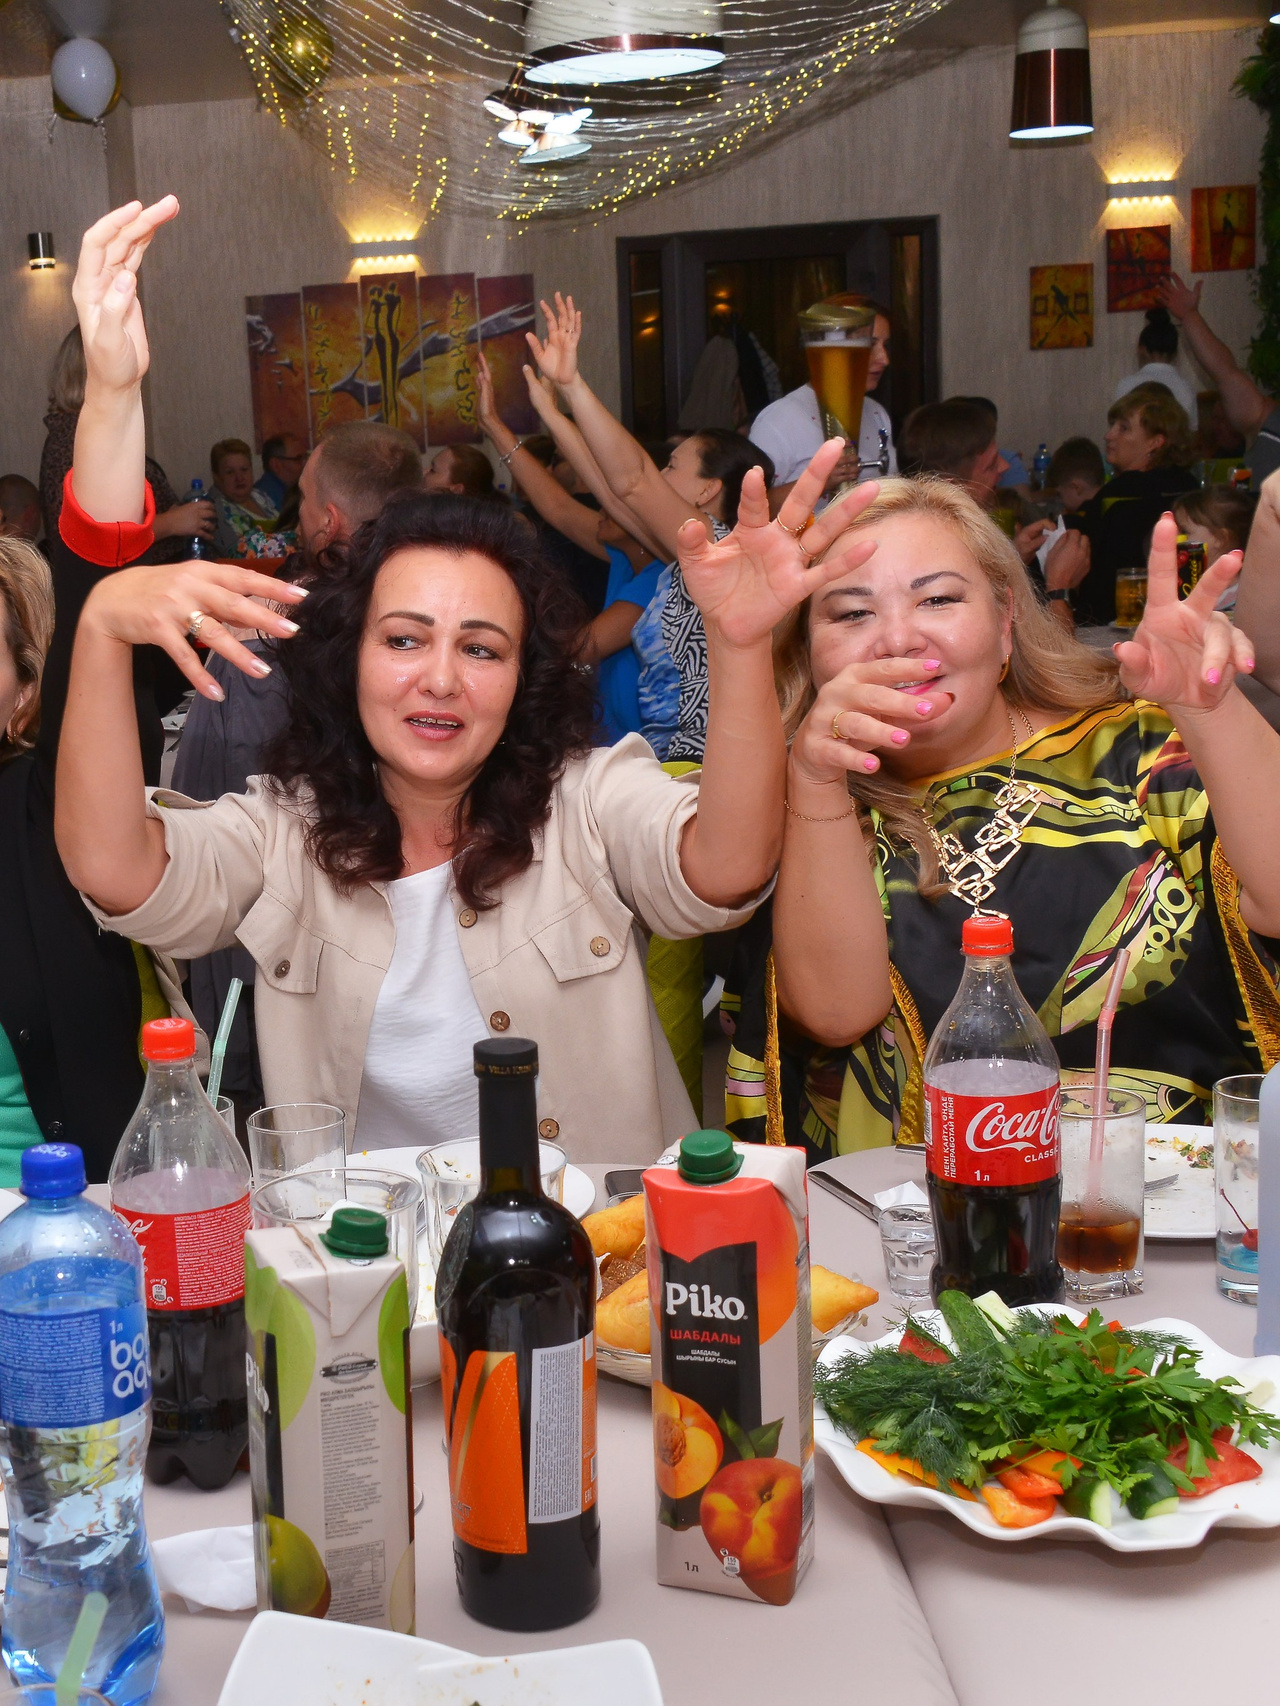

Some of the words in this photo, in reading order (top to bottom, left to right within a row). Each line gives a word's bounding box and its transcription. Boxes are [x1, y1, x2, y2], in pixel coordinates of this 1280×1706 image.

[949, 1121, 957, 1178] ПЕРЕРАБОТАЙ
[665, 1282, 745, 1320] Piko
[670, 1329, 741, 1345] ШАБДАЛЫ
